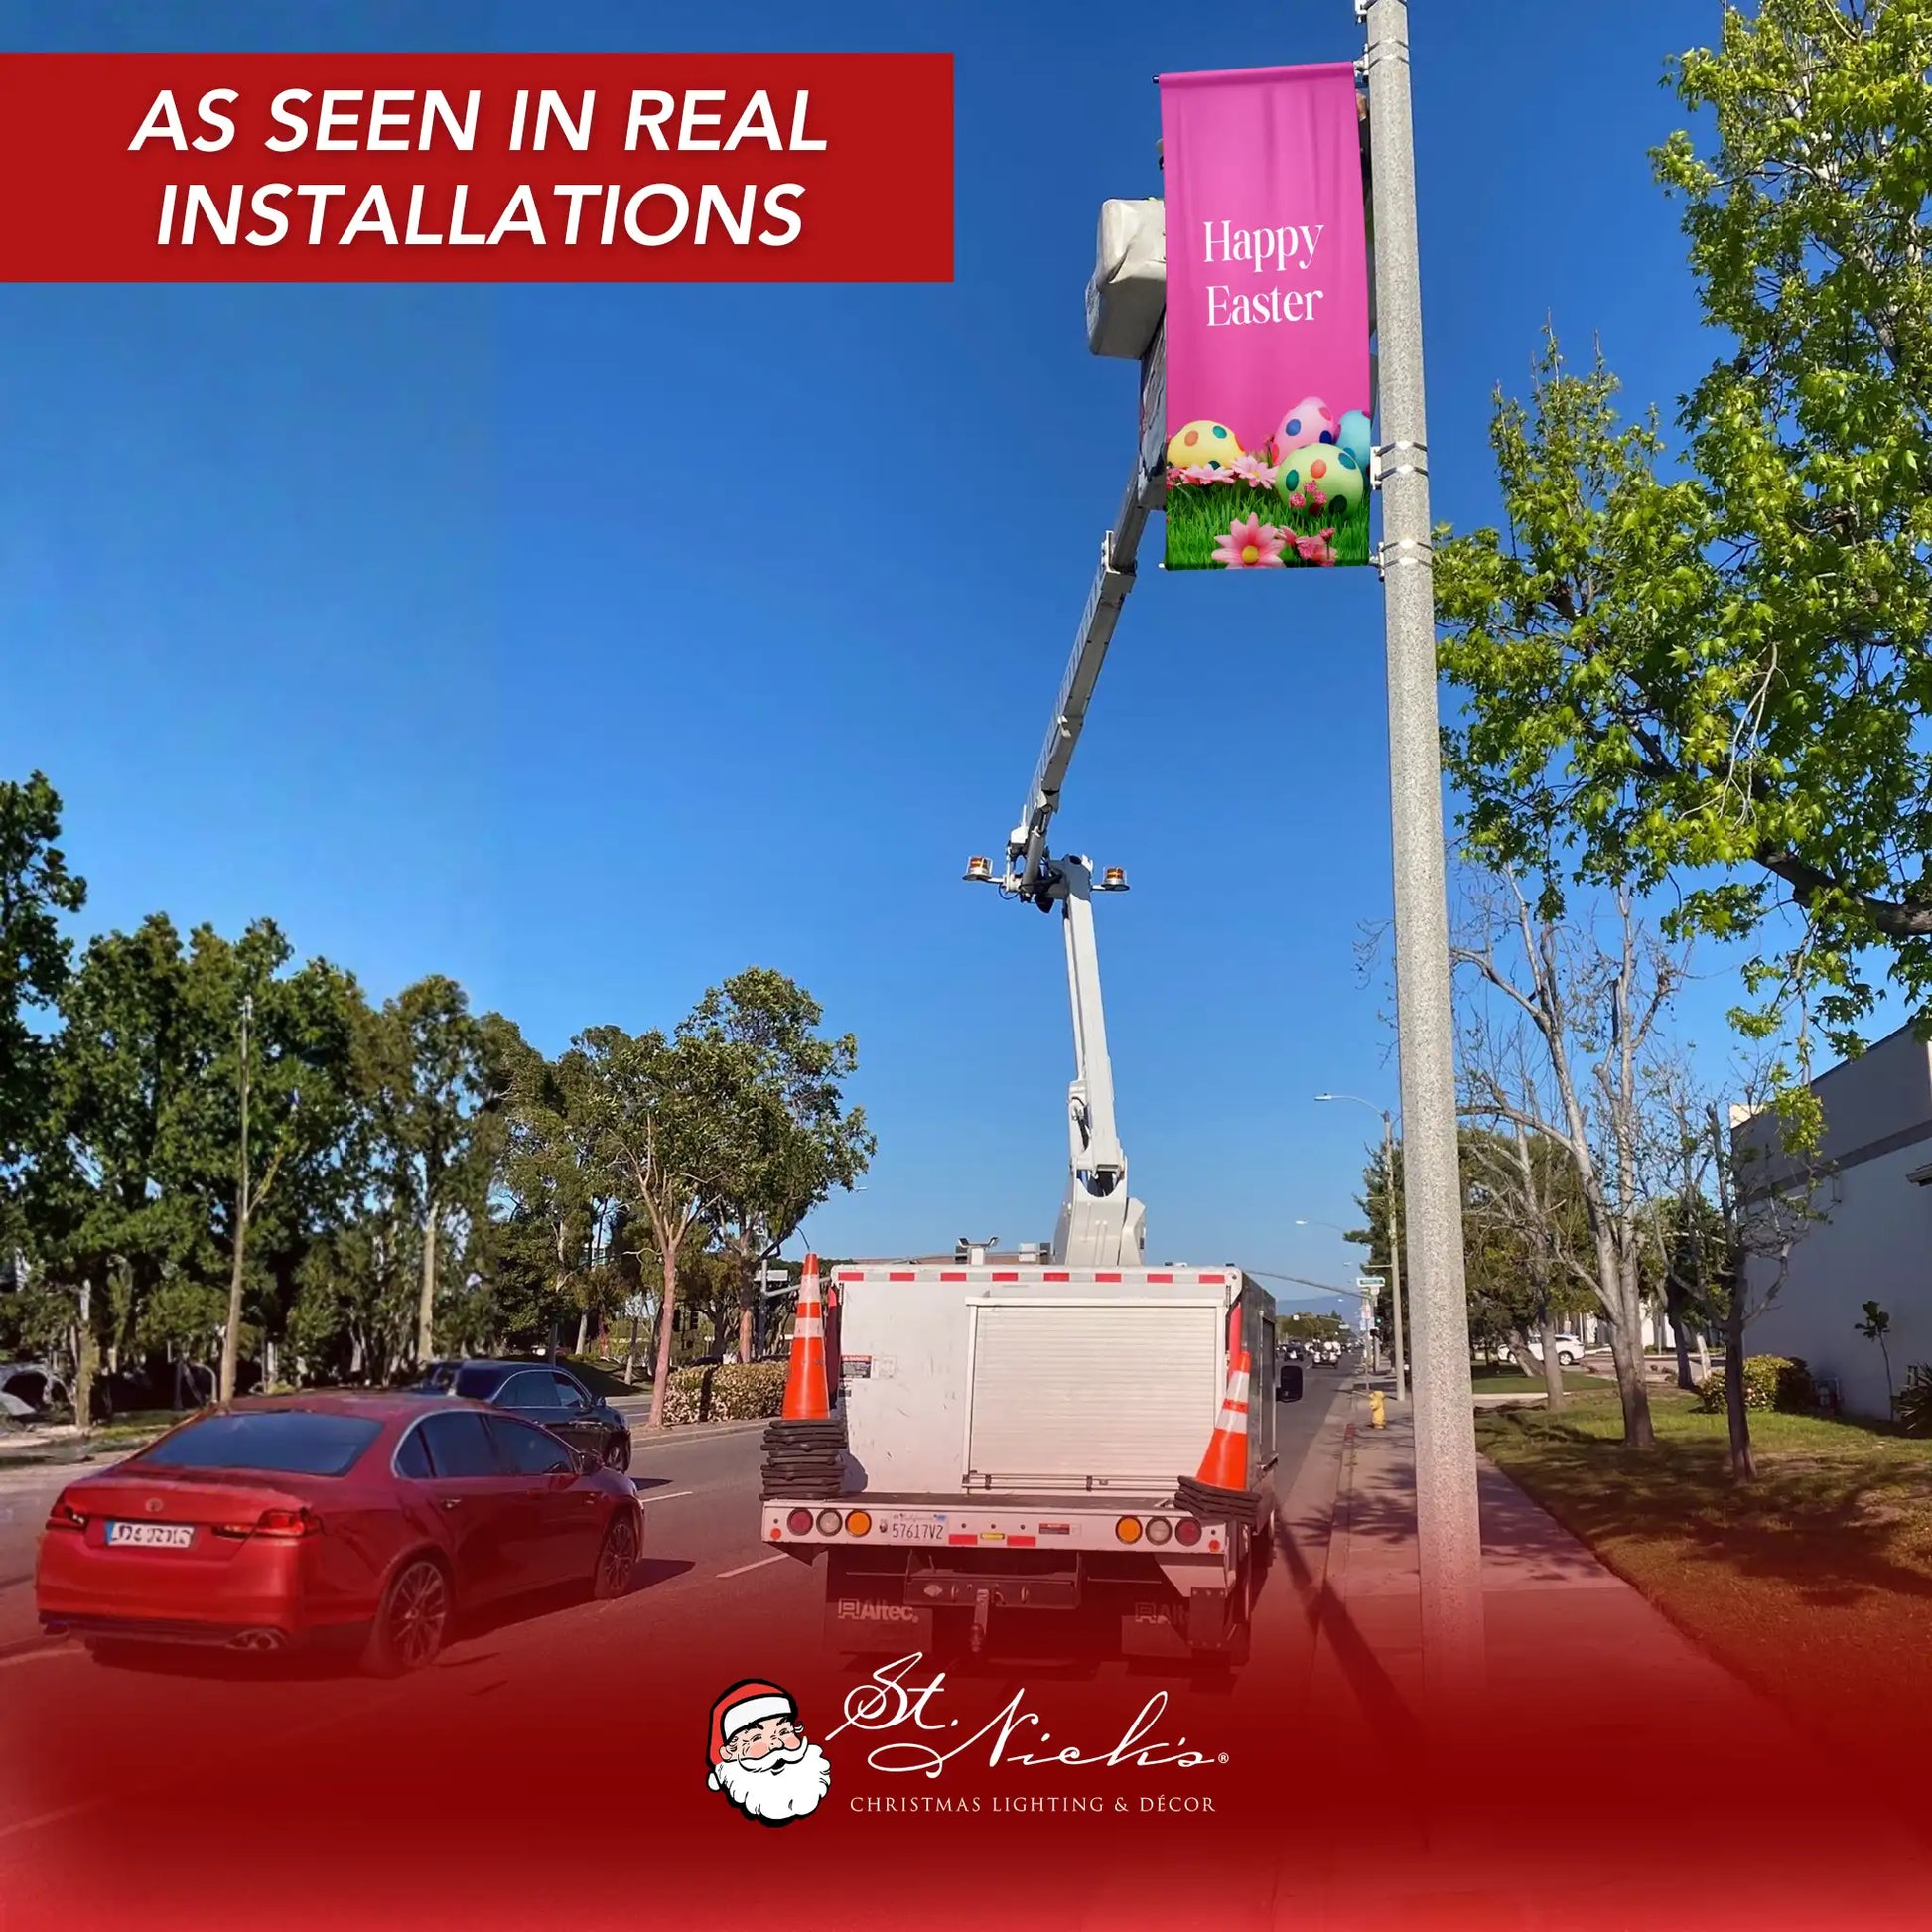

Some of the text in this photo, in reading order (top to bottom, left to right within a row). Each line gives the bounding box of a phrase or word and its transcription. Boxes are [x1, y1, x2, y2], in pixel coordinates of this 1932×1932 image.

[1203, 219, 1325, 273] Happy
[1206, 285, 1325, 327] Easter
[892, 1522, 944, 1540] 57617V2
